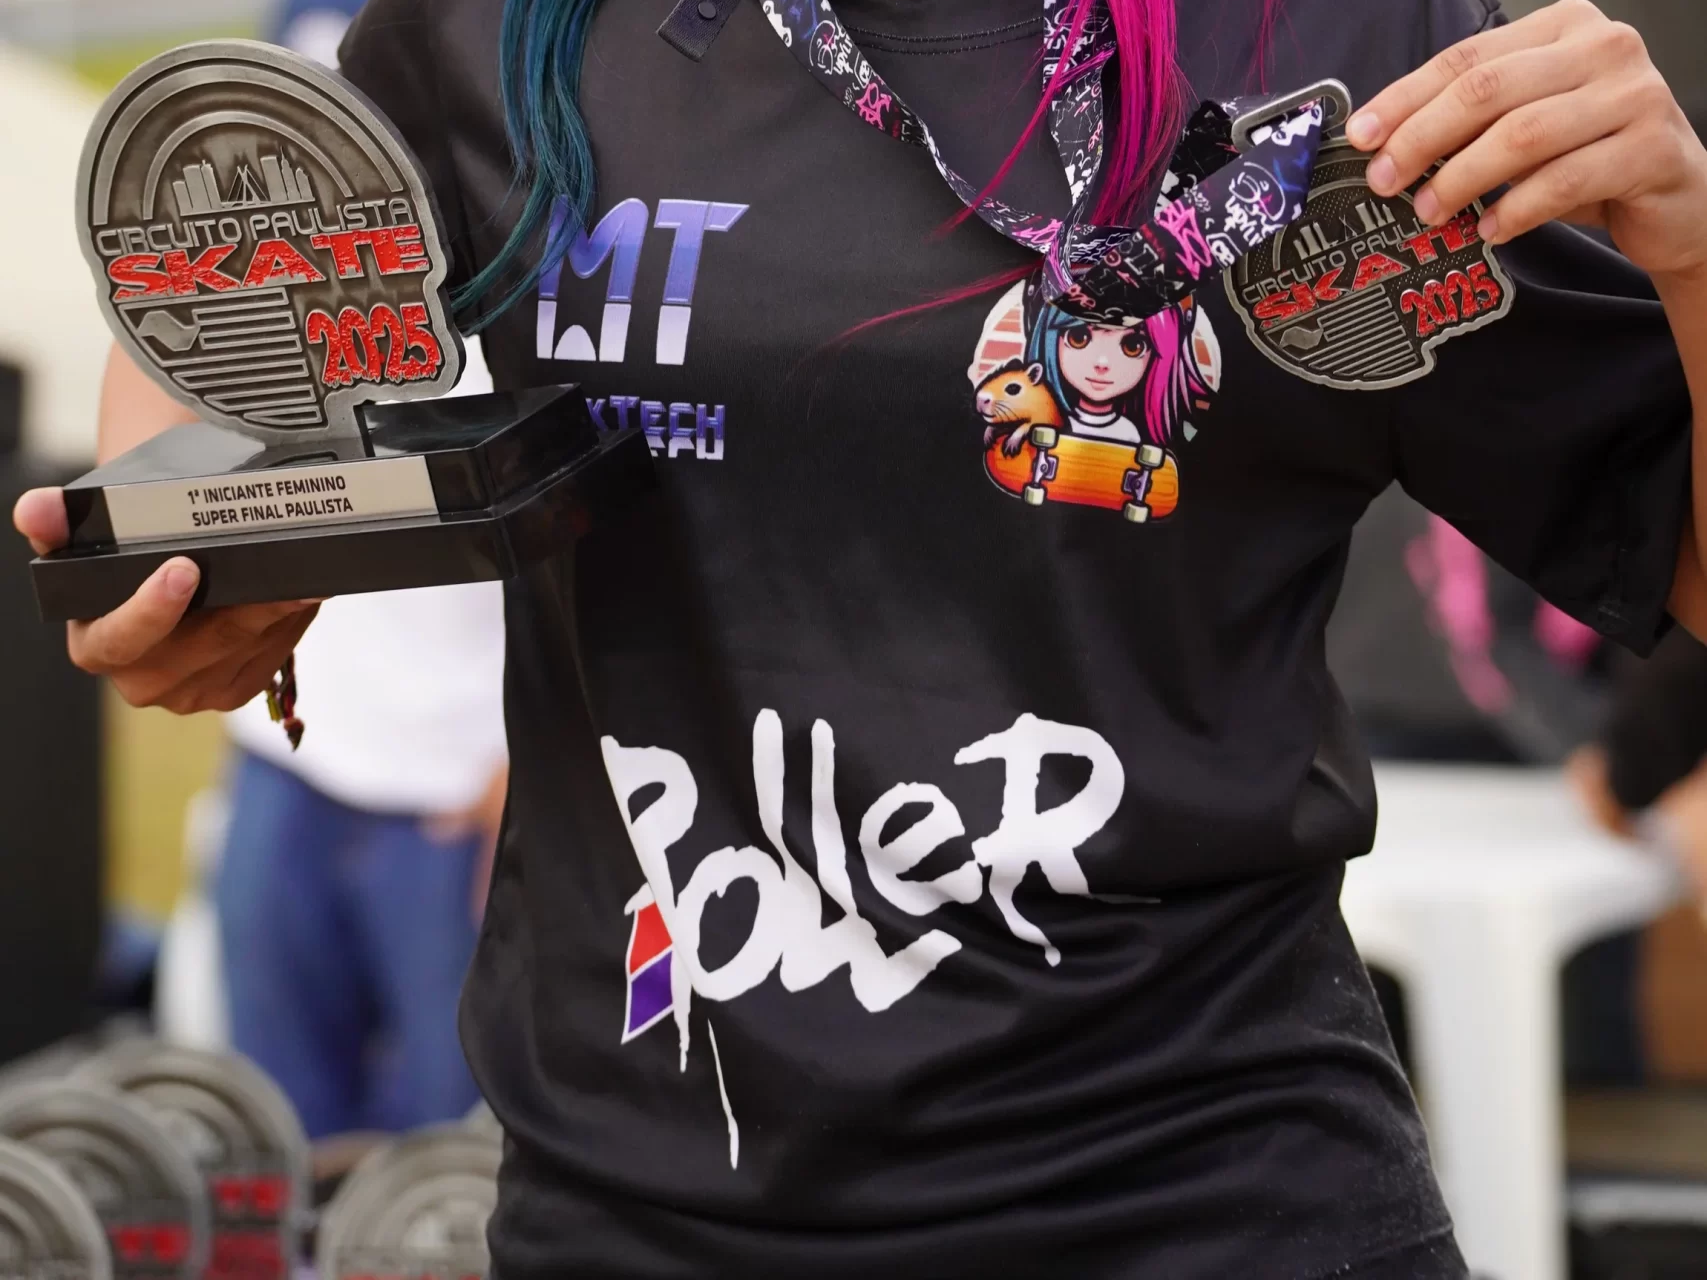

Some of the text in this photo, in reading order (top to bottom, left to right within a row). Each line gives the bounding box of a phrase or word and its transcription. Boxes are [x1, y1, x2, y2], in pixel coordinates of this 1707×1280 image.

[97, 198, 414, 257] CIRCUITO PAULISTA
[108, 224, 430, 303] SKATE
[1242, 248, 1347, 305] CIRCUITO
[1400, 261, 1500, 338] 2025
[305, 302, 442, 388] 2025
[192, 497, 353, 527] SUPER FINAL PAULISTA
[203, 482, 274, 504] INICIANTE
[275, 475, 346, 497] FEMININO
